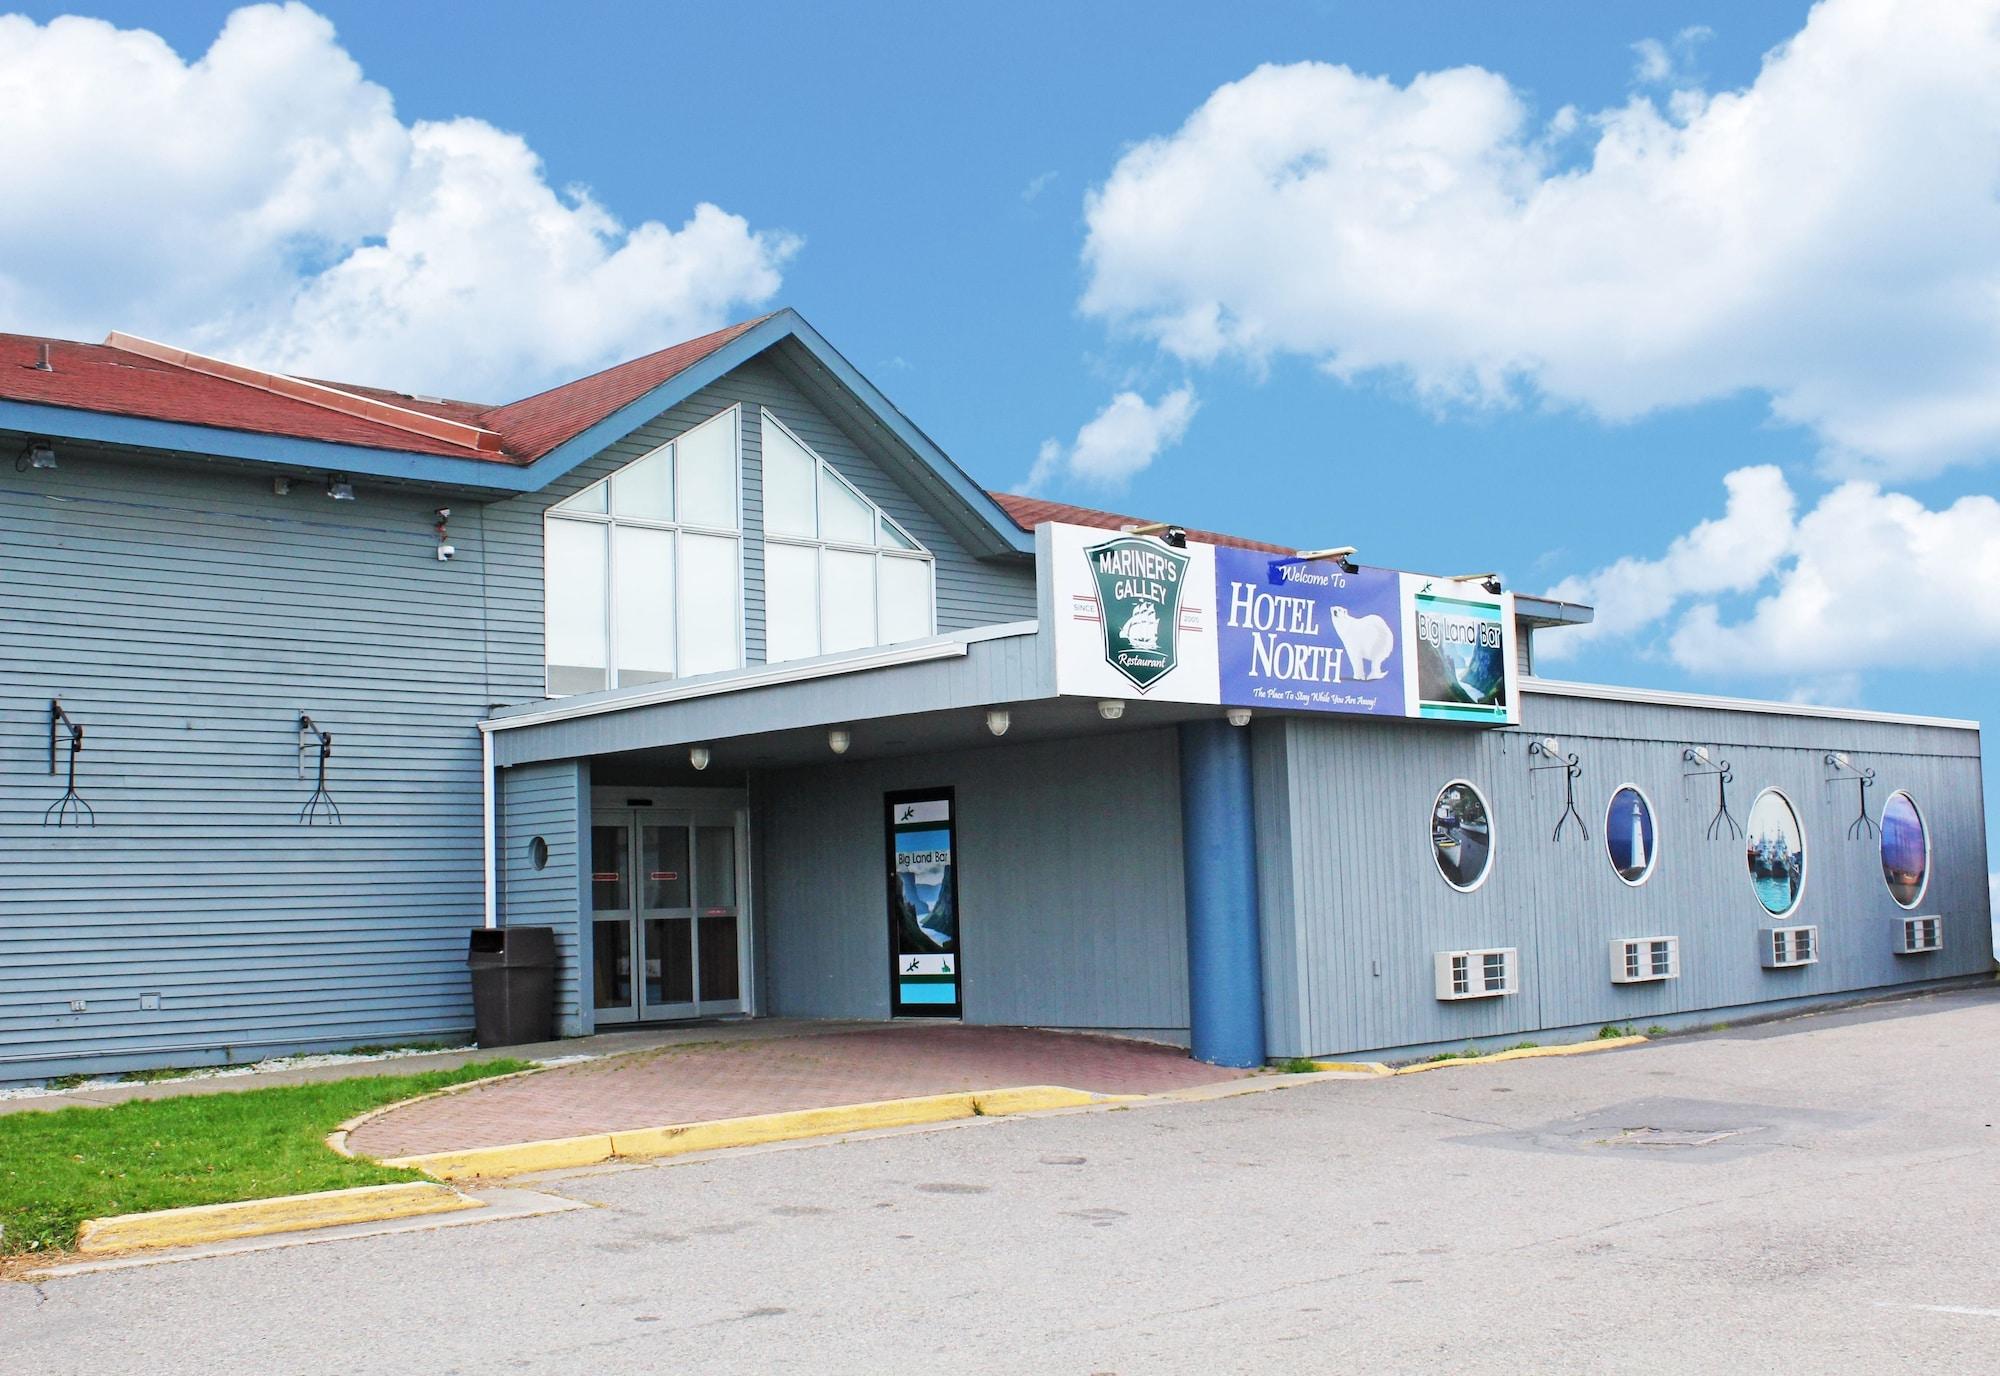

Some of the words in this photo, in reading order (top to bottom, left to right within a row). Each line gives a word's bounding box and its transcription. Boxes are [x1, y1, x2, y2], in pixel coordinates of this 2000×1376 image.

[1099, 550, 1177, 583] MARINER'S
[1279, 565, 1329, 587] Welcome
[1331, 572, 1346, 588] To
[1115, 581, 1167, 605] GALLEY
[1227, 581, 1319, 636] HOTEL
[1419, 613, 1440, 647] Big
[1443, 616, 1476, 644] Land
[1480, 621, 1501, 648] Bar
[1118, 652, 1166, 669] Restaurant
[1249, 631, 1344, 684] NORTH
[1253, 687, 1266, 698] The
[1266, 687, 1284, 700] Place
[1284, 690, 1295, 700] To
[1295, 690, 1311, 706] Stay
[1311, 691, 1330, 703] While
[1330, 694, 1344, 705] You
[1344, 695, 1357, 705] Are
[1357, 695, 1377, 711] Away!
[898, 853, 910, 867] Big
[912, 851, 932, 864] Land
[935, 851, 948, 863] Bar
